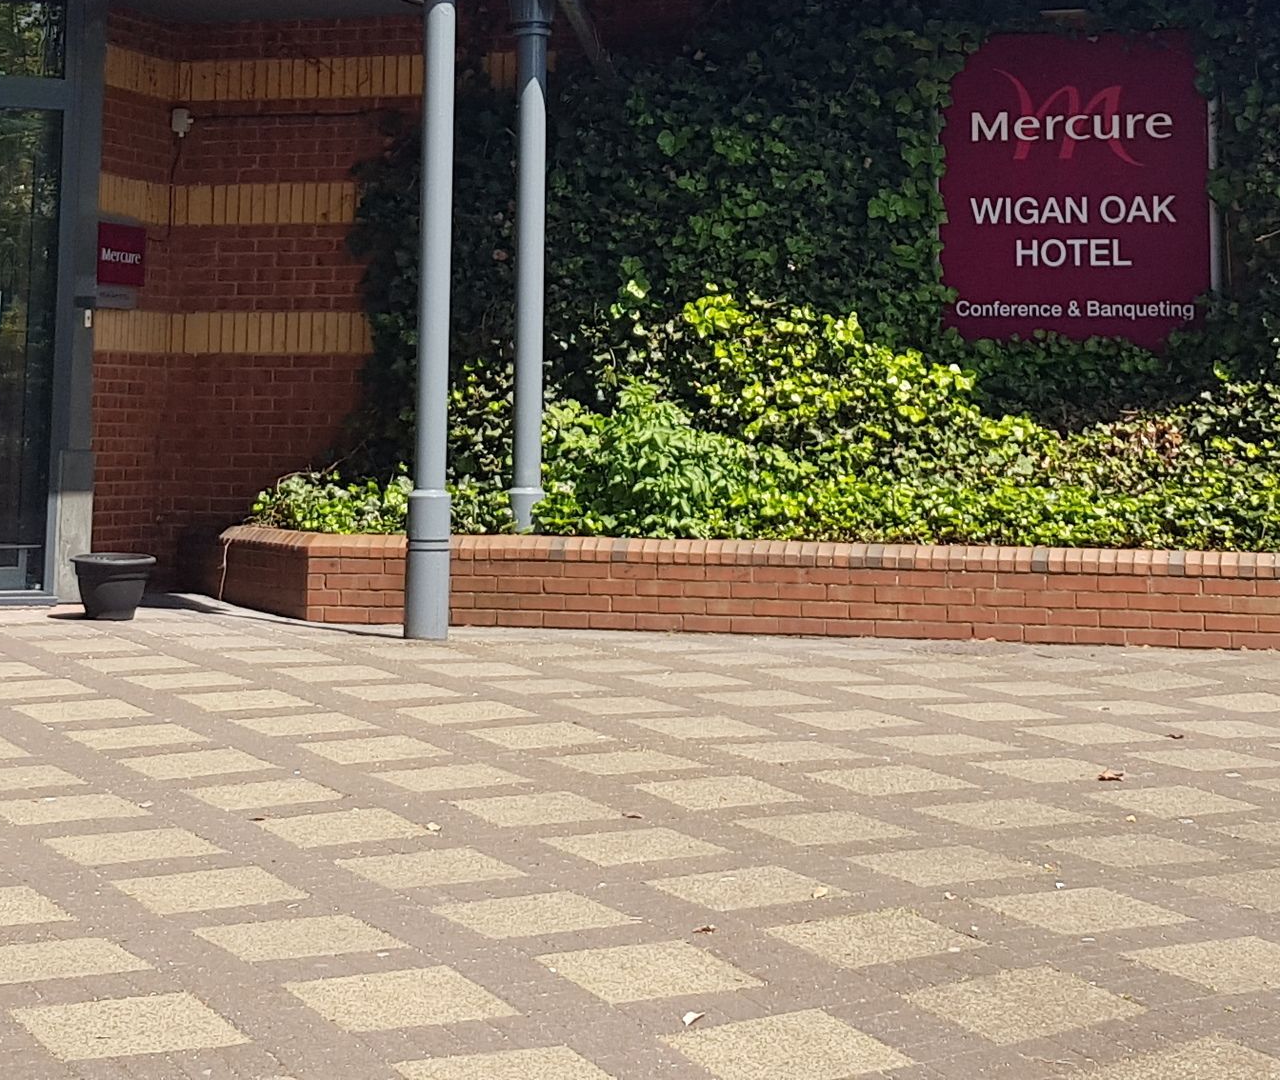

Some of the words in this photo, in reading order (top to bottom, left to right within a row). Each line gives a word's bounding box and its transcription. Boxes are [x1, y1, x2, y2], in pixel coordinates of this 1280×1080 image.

[971, 111, 1173, 142] Mercure
[969, 196, 1088, 224] WIGAN
[1100, 195, 1177, 224] OAK
[101, 248, 141, 264] Mercure
[1016, 238, 1132, 267] HOTEL
[956, 300, 1063, 317] Conference
[1067, 300, 1082, 317] &
[1086, 300, 1195, 320] Banqueting
